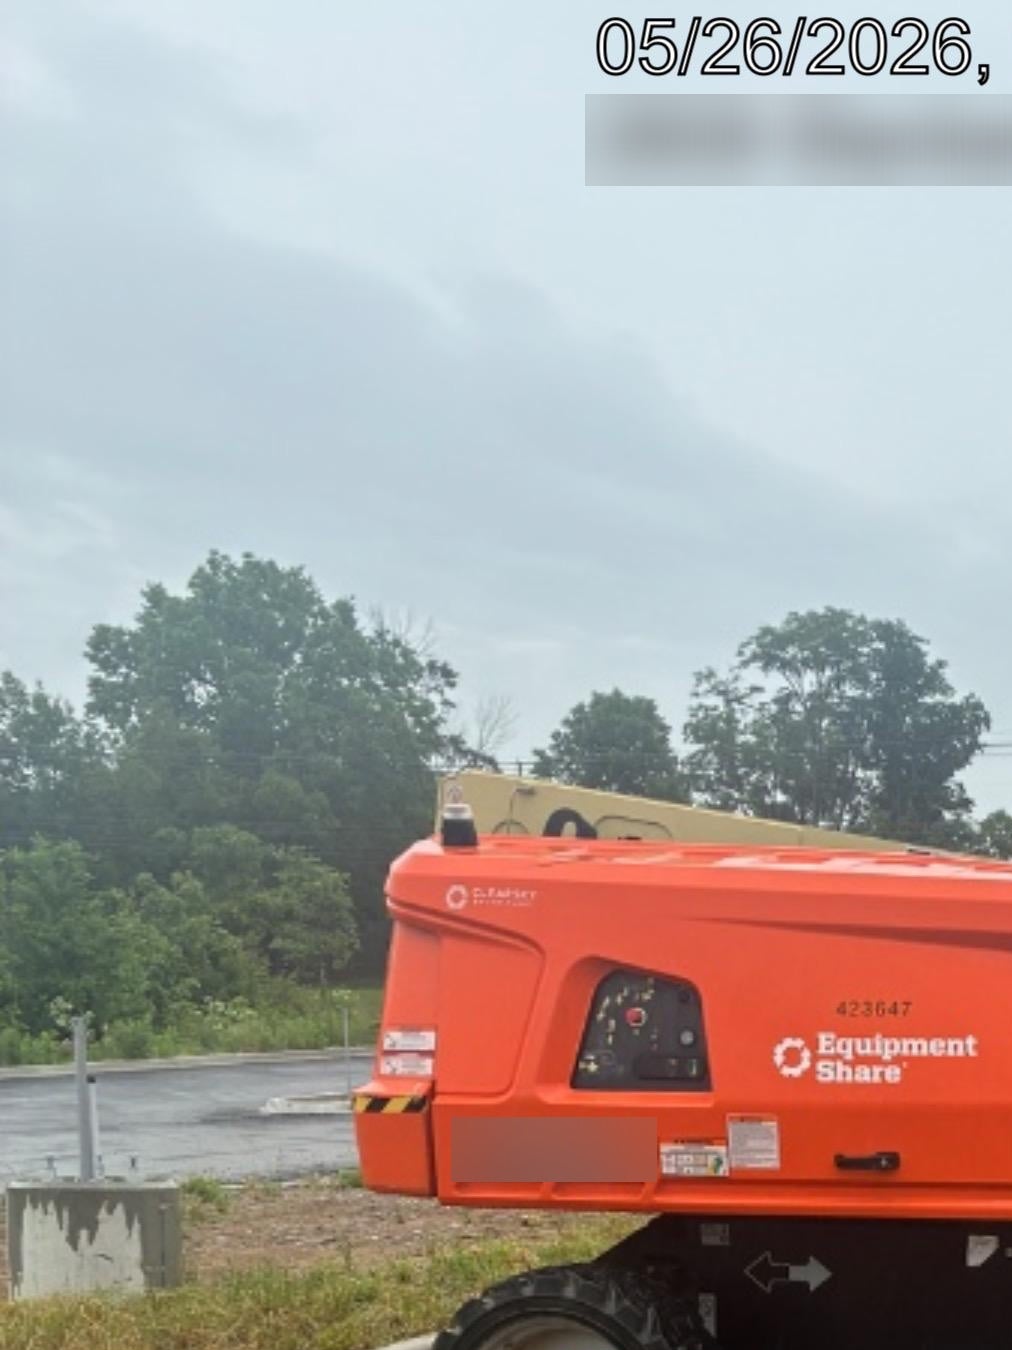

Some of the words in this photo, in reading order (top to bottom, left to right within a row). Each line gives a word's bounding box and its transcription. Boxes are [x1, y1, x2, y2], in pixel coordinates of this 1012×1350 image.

[836, 1001, 912, 1017] 423647
[816, 1032, 978, 1060] Equipment
[816, 1059, 901, 1083] Share
